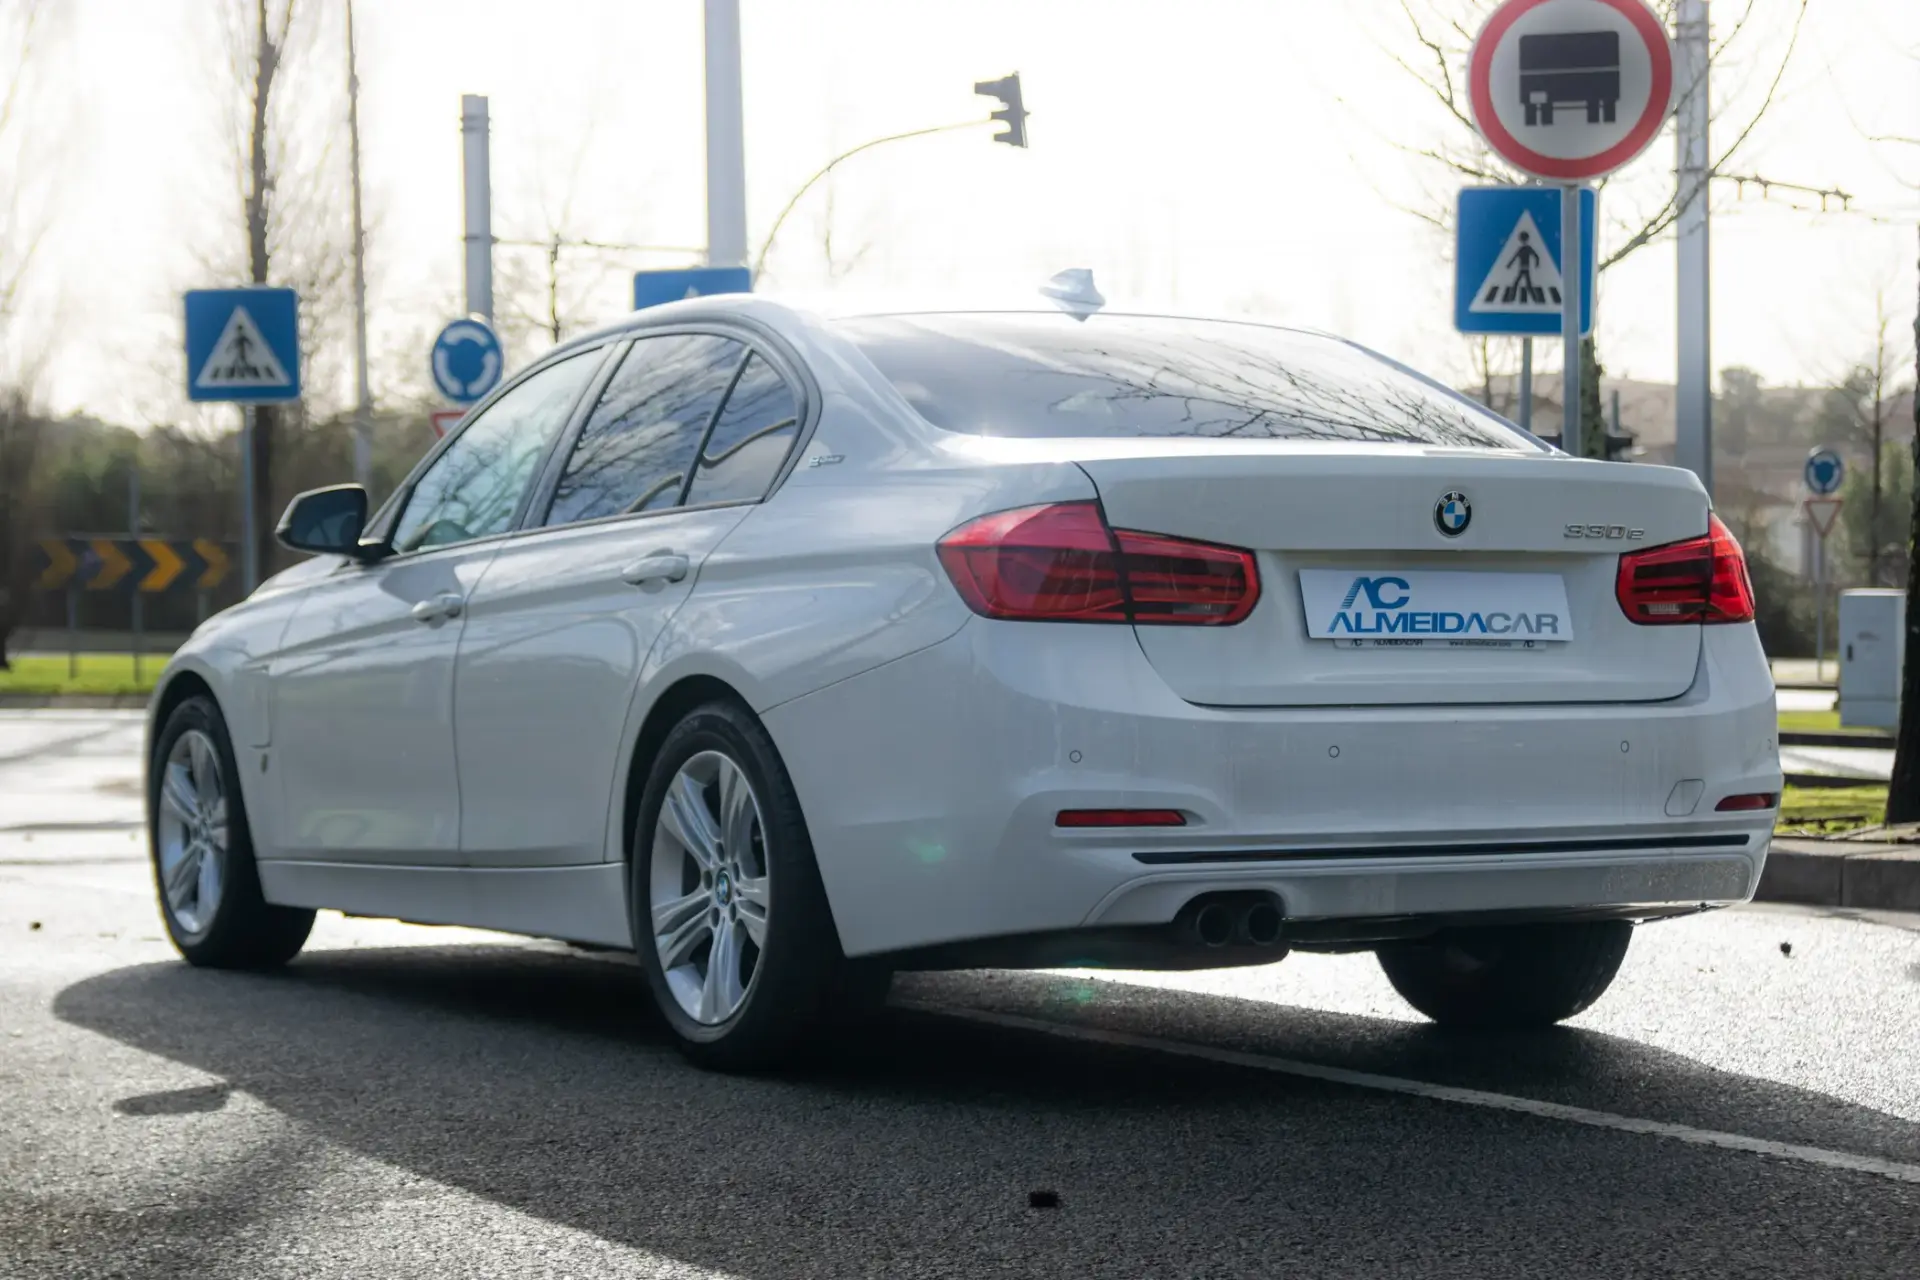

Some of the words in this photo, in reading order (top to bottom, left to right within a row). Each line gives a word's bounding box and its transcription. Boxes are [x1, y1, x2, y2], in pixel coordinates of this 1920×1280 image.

[1563, 523, 1645, 541] 330e
[1341, 576, 1410, 610] AC
[1326, 611, 1559, 635] ALMEIDACAR
